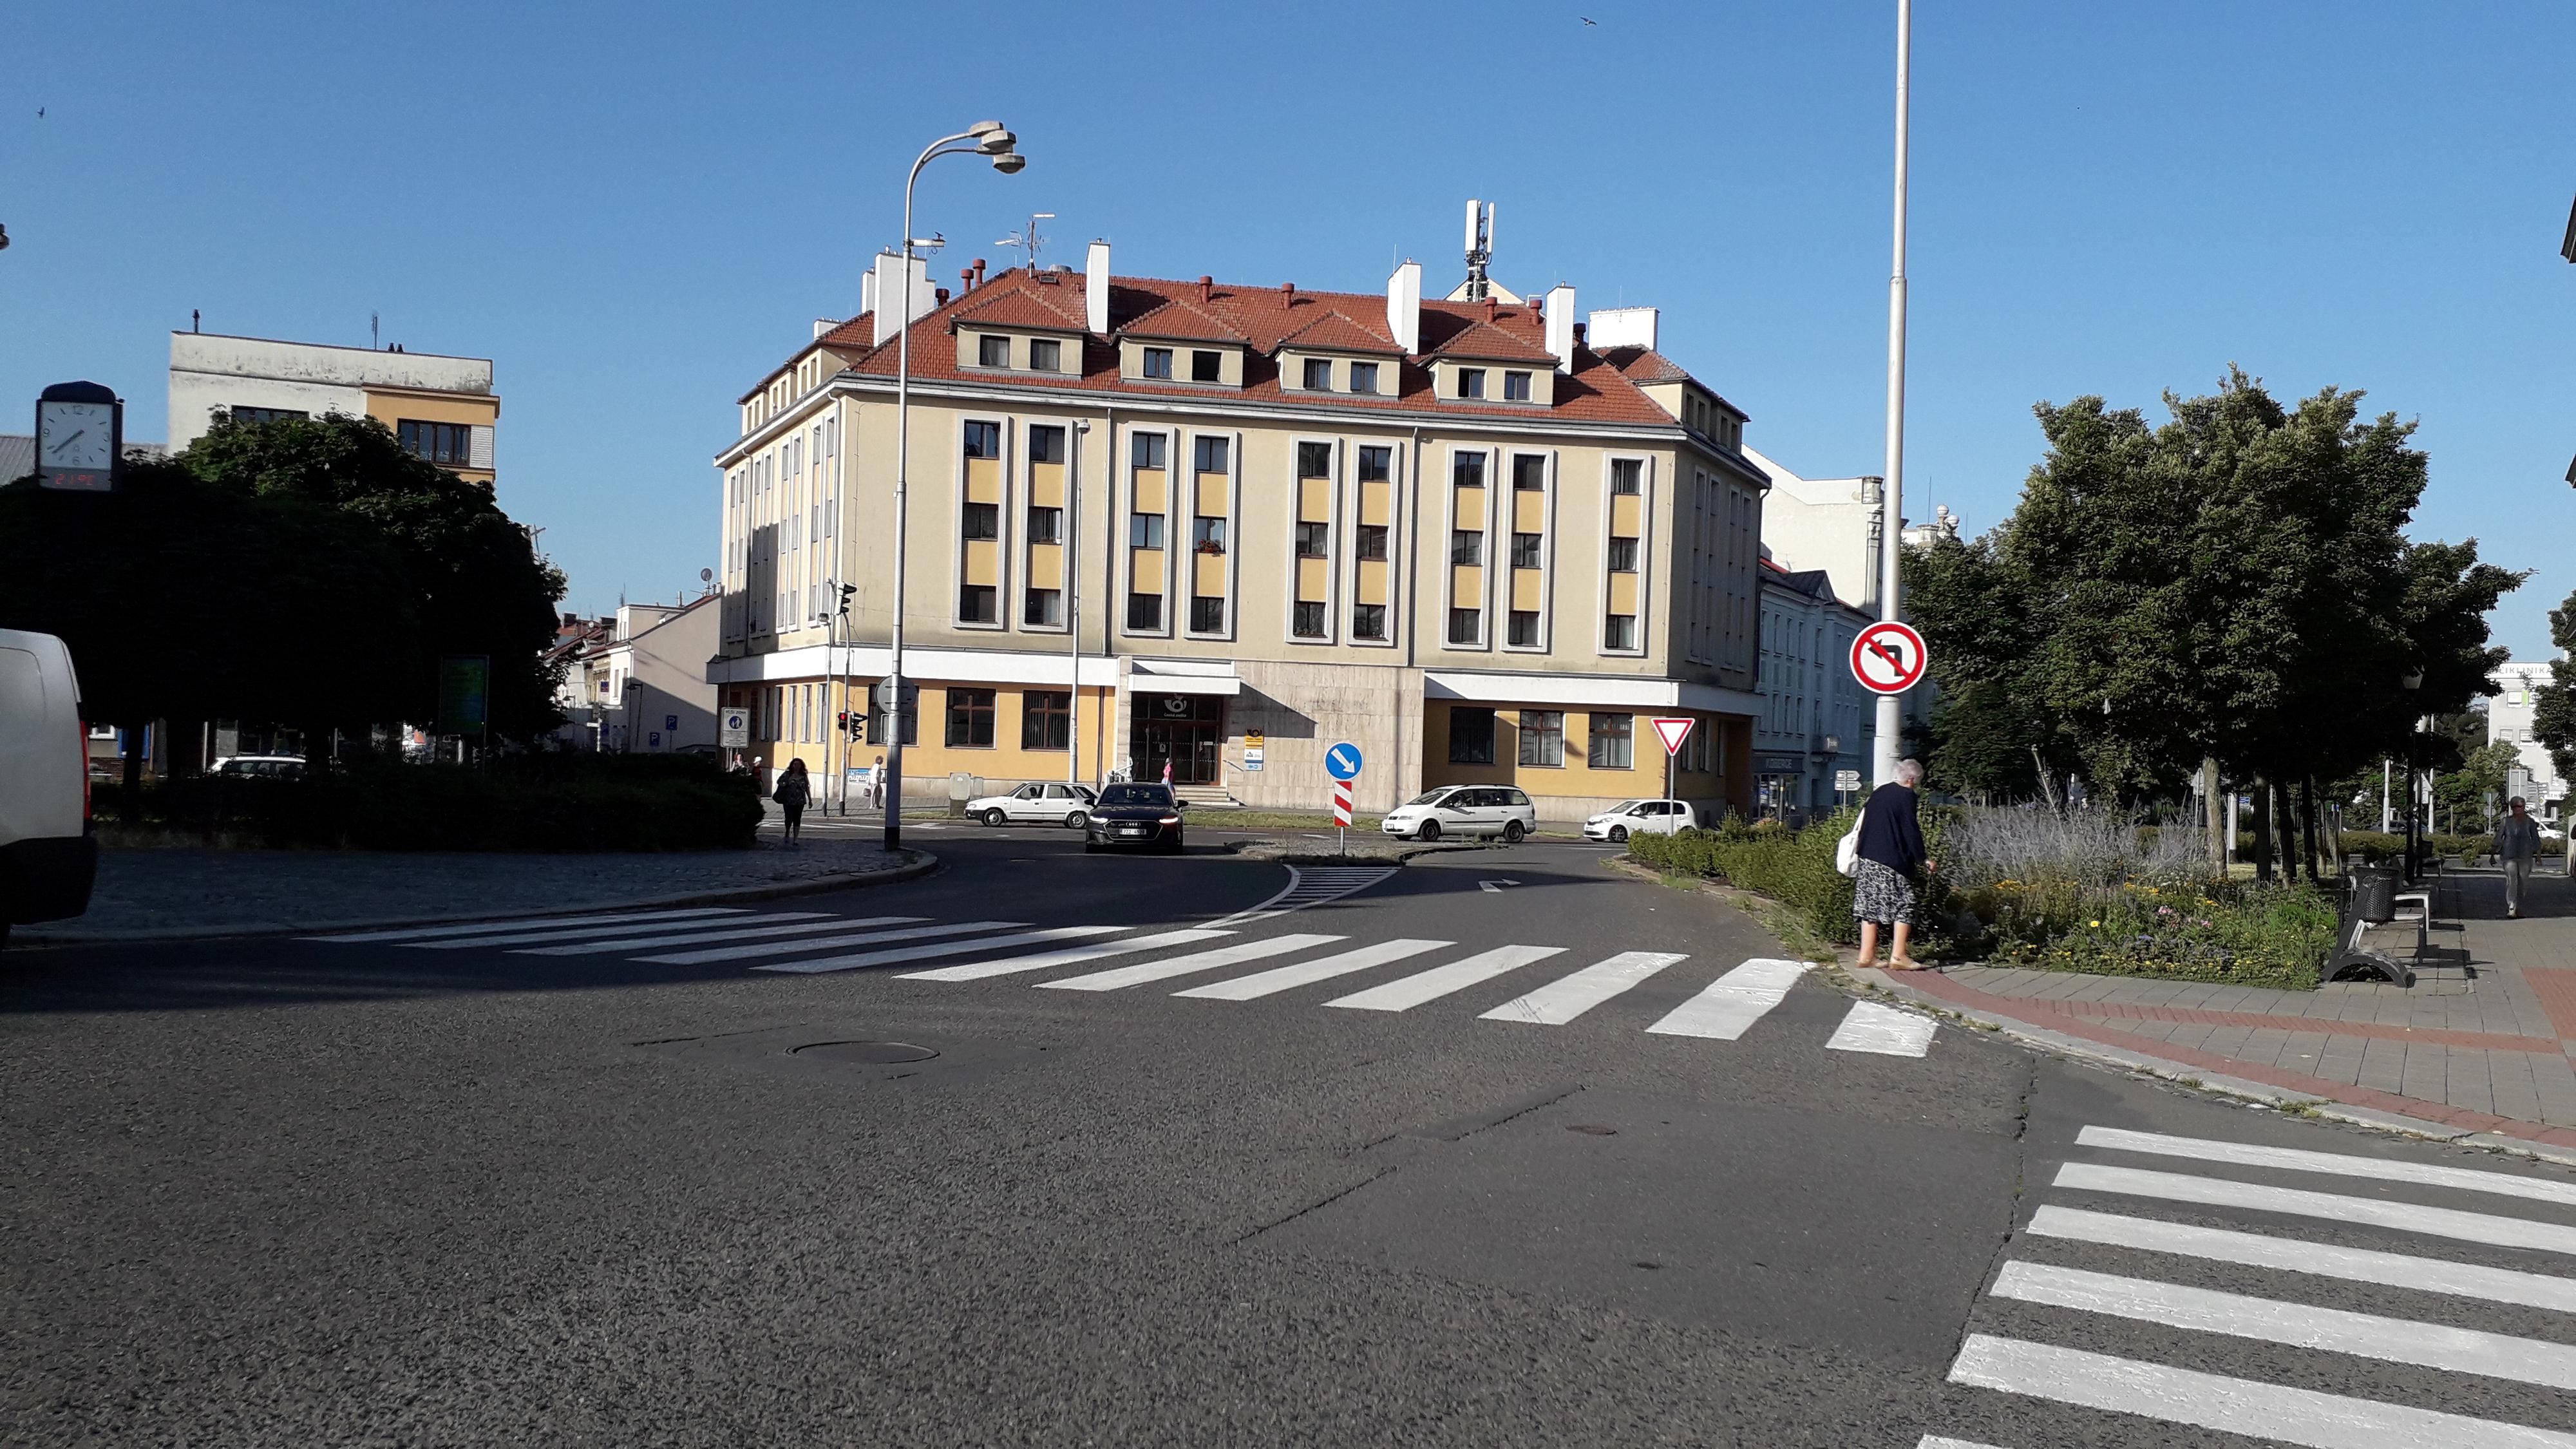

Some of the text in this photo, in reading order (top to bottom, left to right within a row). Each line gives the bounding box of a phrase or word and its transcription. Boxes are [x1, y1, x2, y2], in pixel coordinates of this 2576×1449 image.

[73, 405, 84, 415] 12
[43, 428, 50, 437] 9
[103, 432, 110, 442] 3
[72, 456, 80, 466] 6
[668, 717, 675, 725] P
[652, 734, 658, 742] P
